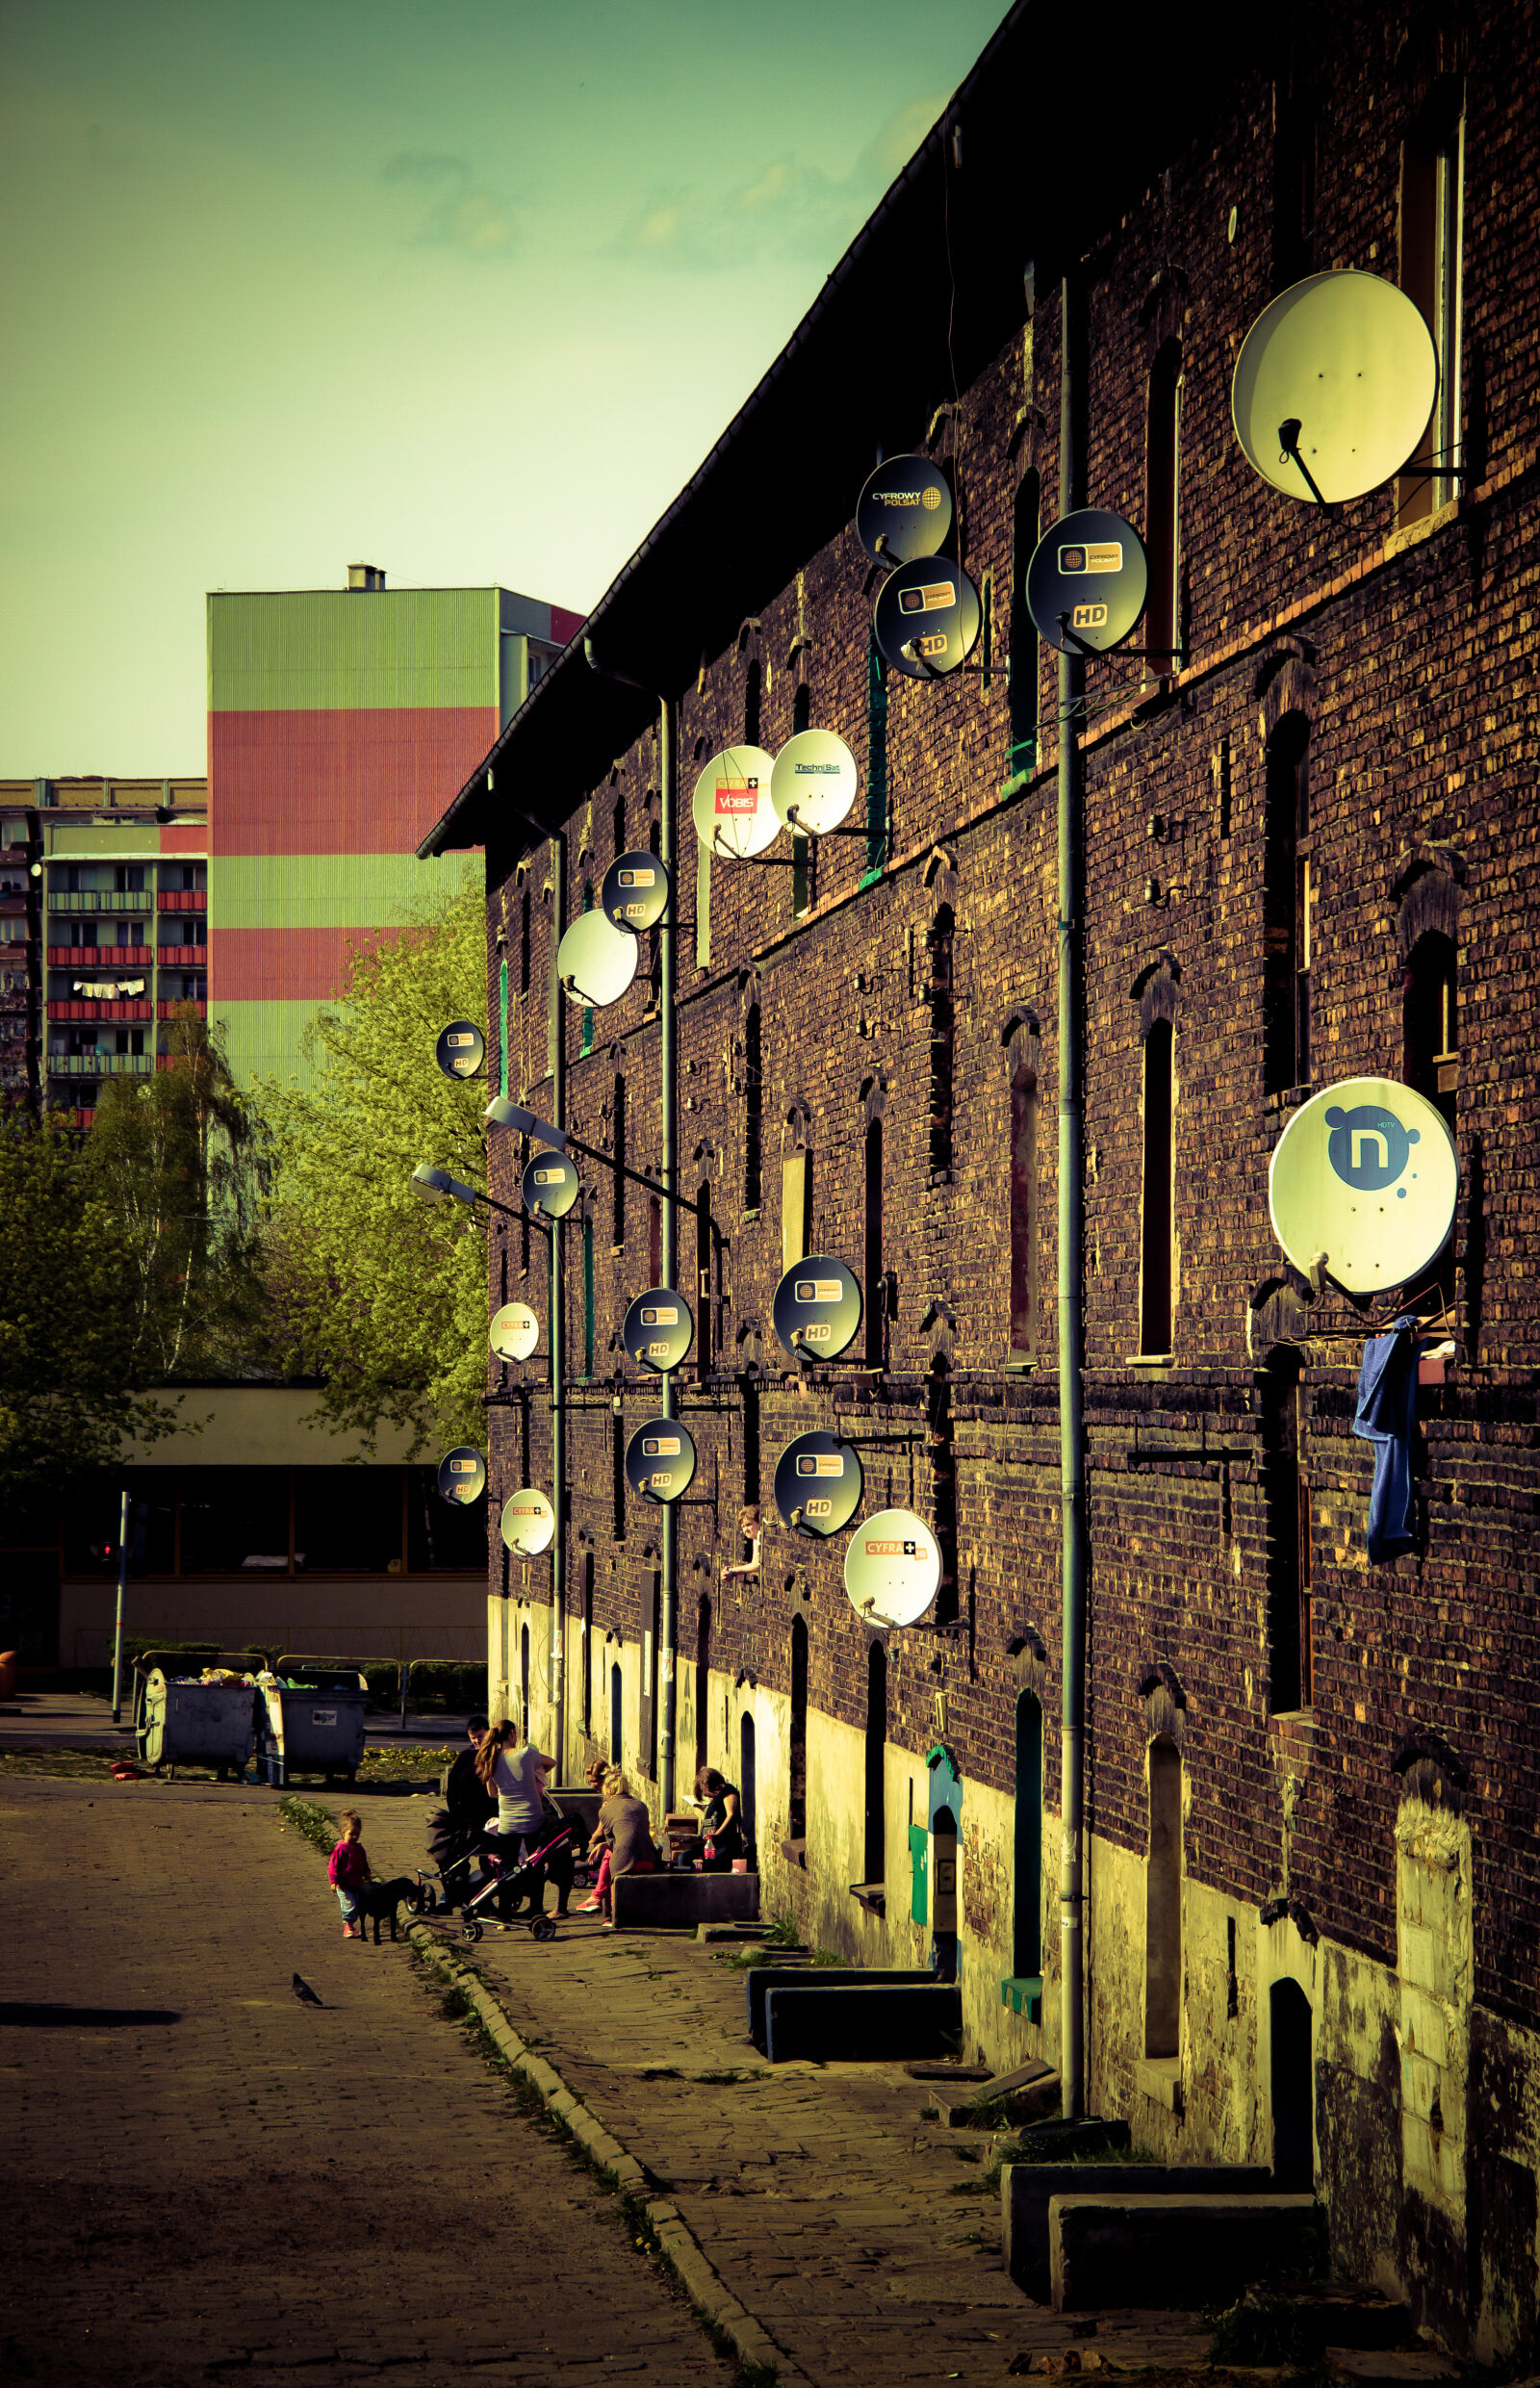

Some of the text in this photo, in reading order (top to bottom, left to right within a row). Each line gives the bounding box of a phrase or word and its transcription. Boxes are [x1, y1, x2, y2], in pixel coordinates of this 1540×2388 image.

[872, 492, 921, 501] CYFROWY
[1075, 606, 1106, 626] HD
[921, 636, 945, 655] HD
[719, 793, 754, 809] VOBIS
[628, 905, 645, 915] HD
[455, 1059, 468, 1067] HD
[1350, 1129, 1389, 1168] n
[808, 1326, 830, 1340] HD
[651, 1344, 668, 1355] HD
[654, 1475, 670, 1486] HD
[808, 1502, 831, 1514] HD
